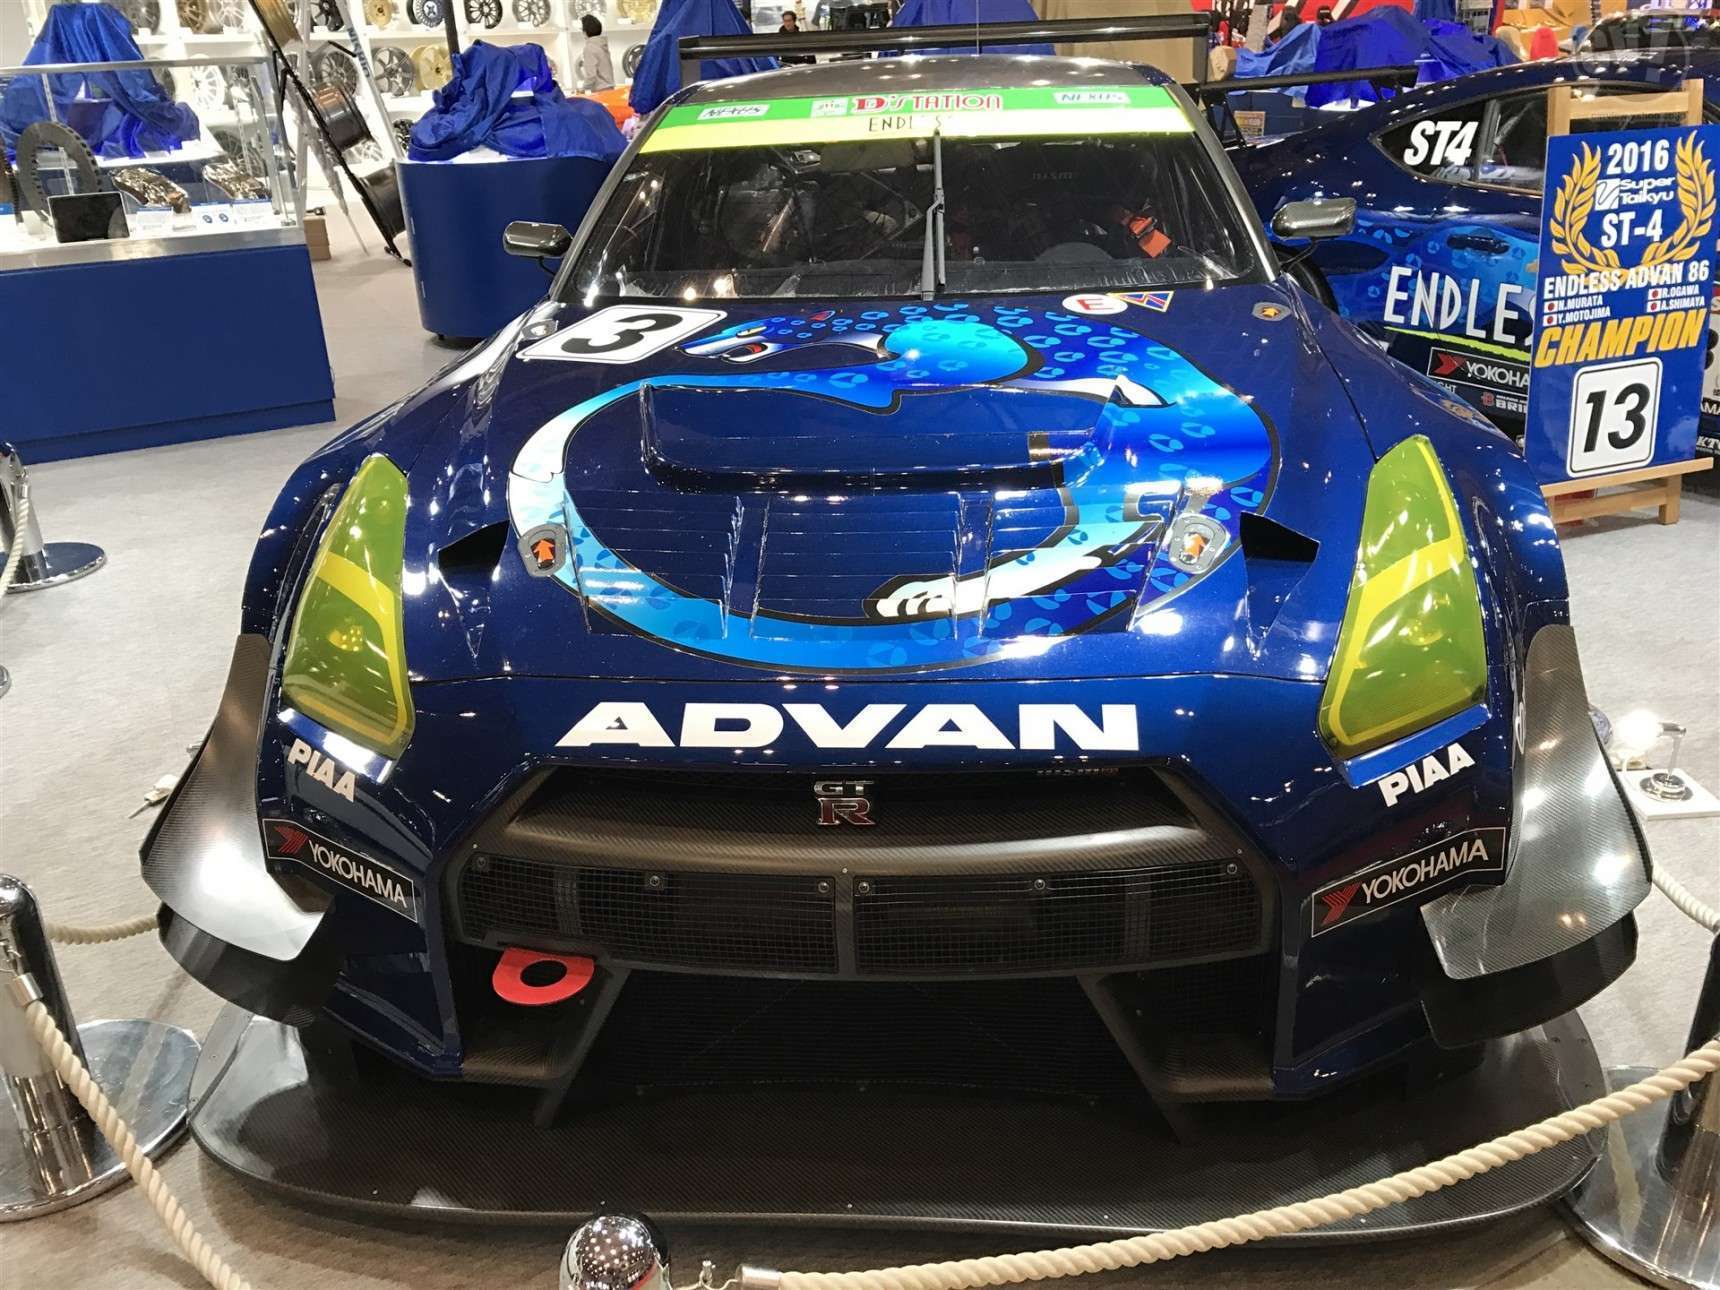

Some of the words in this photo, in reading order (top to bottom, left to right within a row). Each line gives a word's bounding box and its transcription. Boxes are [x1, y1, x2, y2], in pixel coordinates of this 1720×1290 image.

[1403, 120, 1479, 165] ST4
[1607, 139, 1670, 175] 2016
[1619, 177, 1675, 193] Super
[1620, 190, 1675, 205] Taikyu
[1601, 209, 1662, 248] ST-4
[1544, 268, 1623, 299] ENDLESS
[1625, 262, 1684, 289] ADVAN
[1688, 260, 1710, 282] 86
[1661, 284, 1700, 298] R.OGAWA
[1383, 265, 1535, 347] ENDLE
[1557, 307, 1611, 324] Y.MOTOJIMA
[1660, 296, 1705, 311] A.SHIMAYA
[561, 313, 683, 354] 3
[1534, 308, 1708, 368] CHAMPION
[1583, 382, 1651, 453] 13
[554, 702, 1140, 752] ADVAN
[287, 738, 356, 803] PIAA
[813, 780, 875, 796] GT
[1378, 742, 1476, 808] PIAA
[816, 797, 876, 825] R
[308, 839, 408, 909] YOKOHAMA
[1361, 838, 1490, 904] YOKOHAMA
